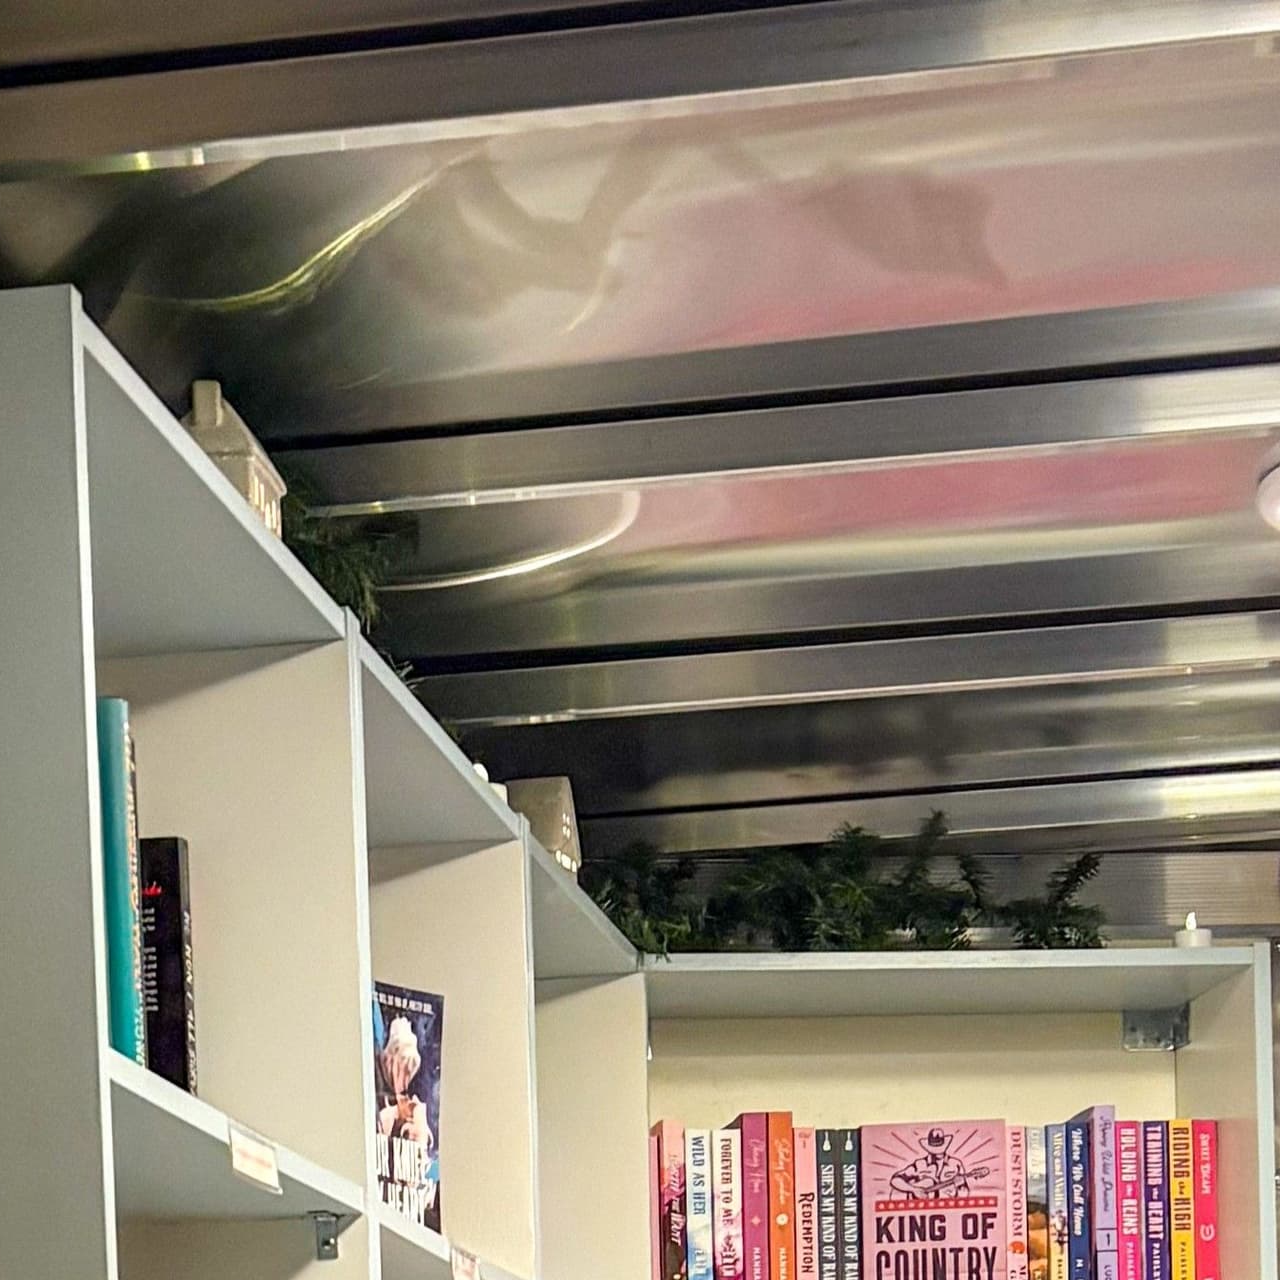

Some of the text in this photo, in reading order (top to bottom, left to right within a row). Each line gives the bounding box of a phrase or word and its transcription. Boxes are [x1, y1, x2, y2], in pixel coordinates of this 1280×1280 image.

[692, 1136, 706, 1215] WILD AS HER
[720, 1138, 734, 1225] FOREVER TO ME
[1011, 1131, 1025, 1237] DUST STORM
[1120, 1128, 1137, 1235] HOLDING REINS
[1146, 1126, 1163, 1239] TRAINING HEART
[1172, 1127, 1191, 1231] RIDING HIGH
[798, 1192, 815, 1273] REDEMPTION
[875, 1211, 998, 1244] KING OF
